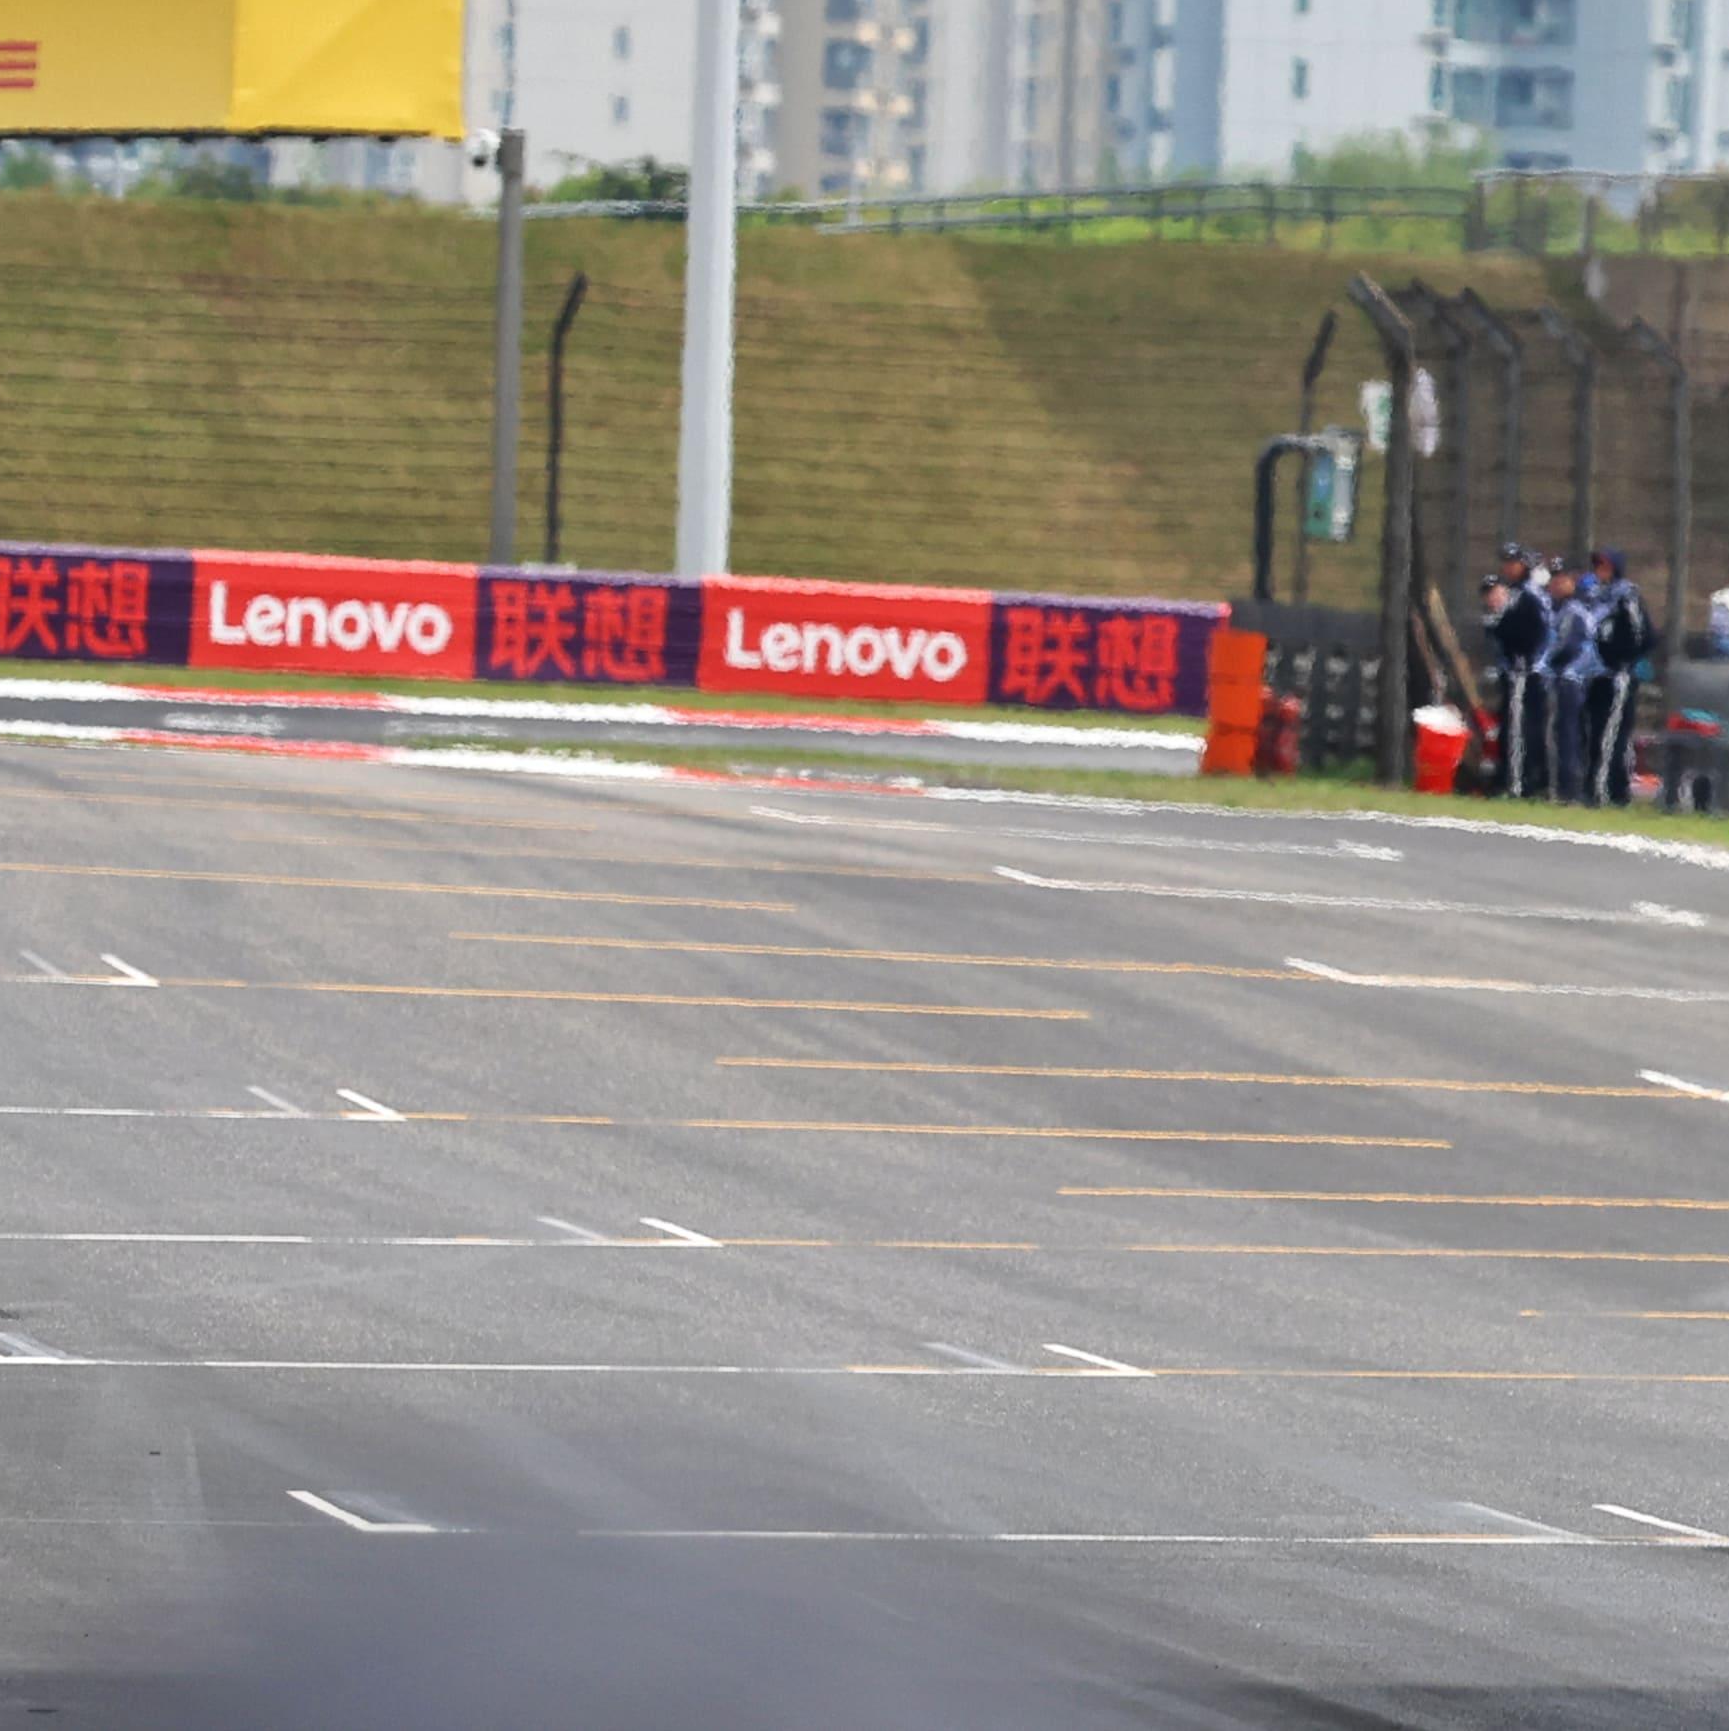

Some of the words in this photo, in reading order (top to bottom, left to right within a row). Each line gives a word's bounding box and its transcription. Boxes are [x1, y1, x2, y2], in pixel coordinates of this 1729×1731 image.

[209, 579, 453, 655] Lenovo
[489, 580, 669, 681] 联想
[725, 606, 968, 682] Lenovo
[1001, 607, 1179, 711] 联想
